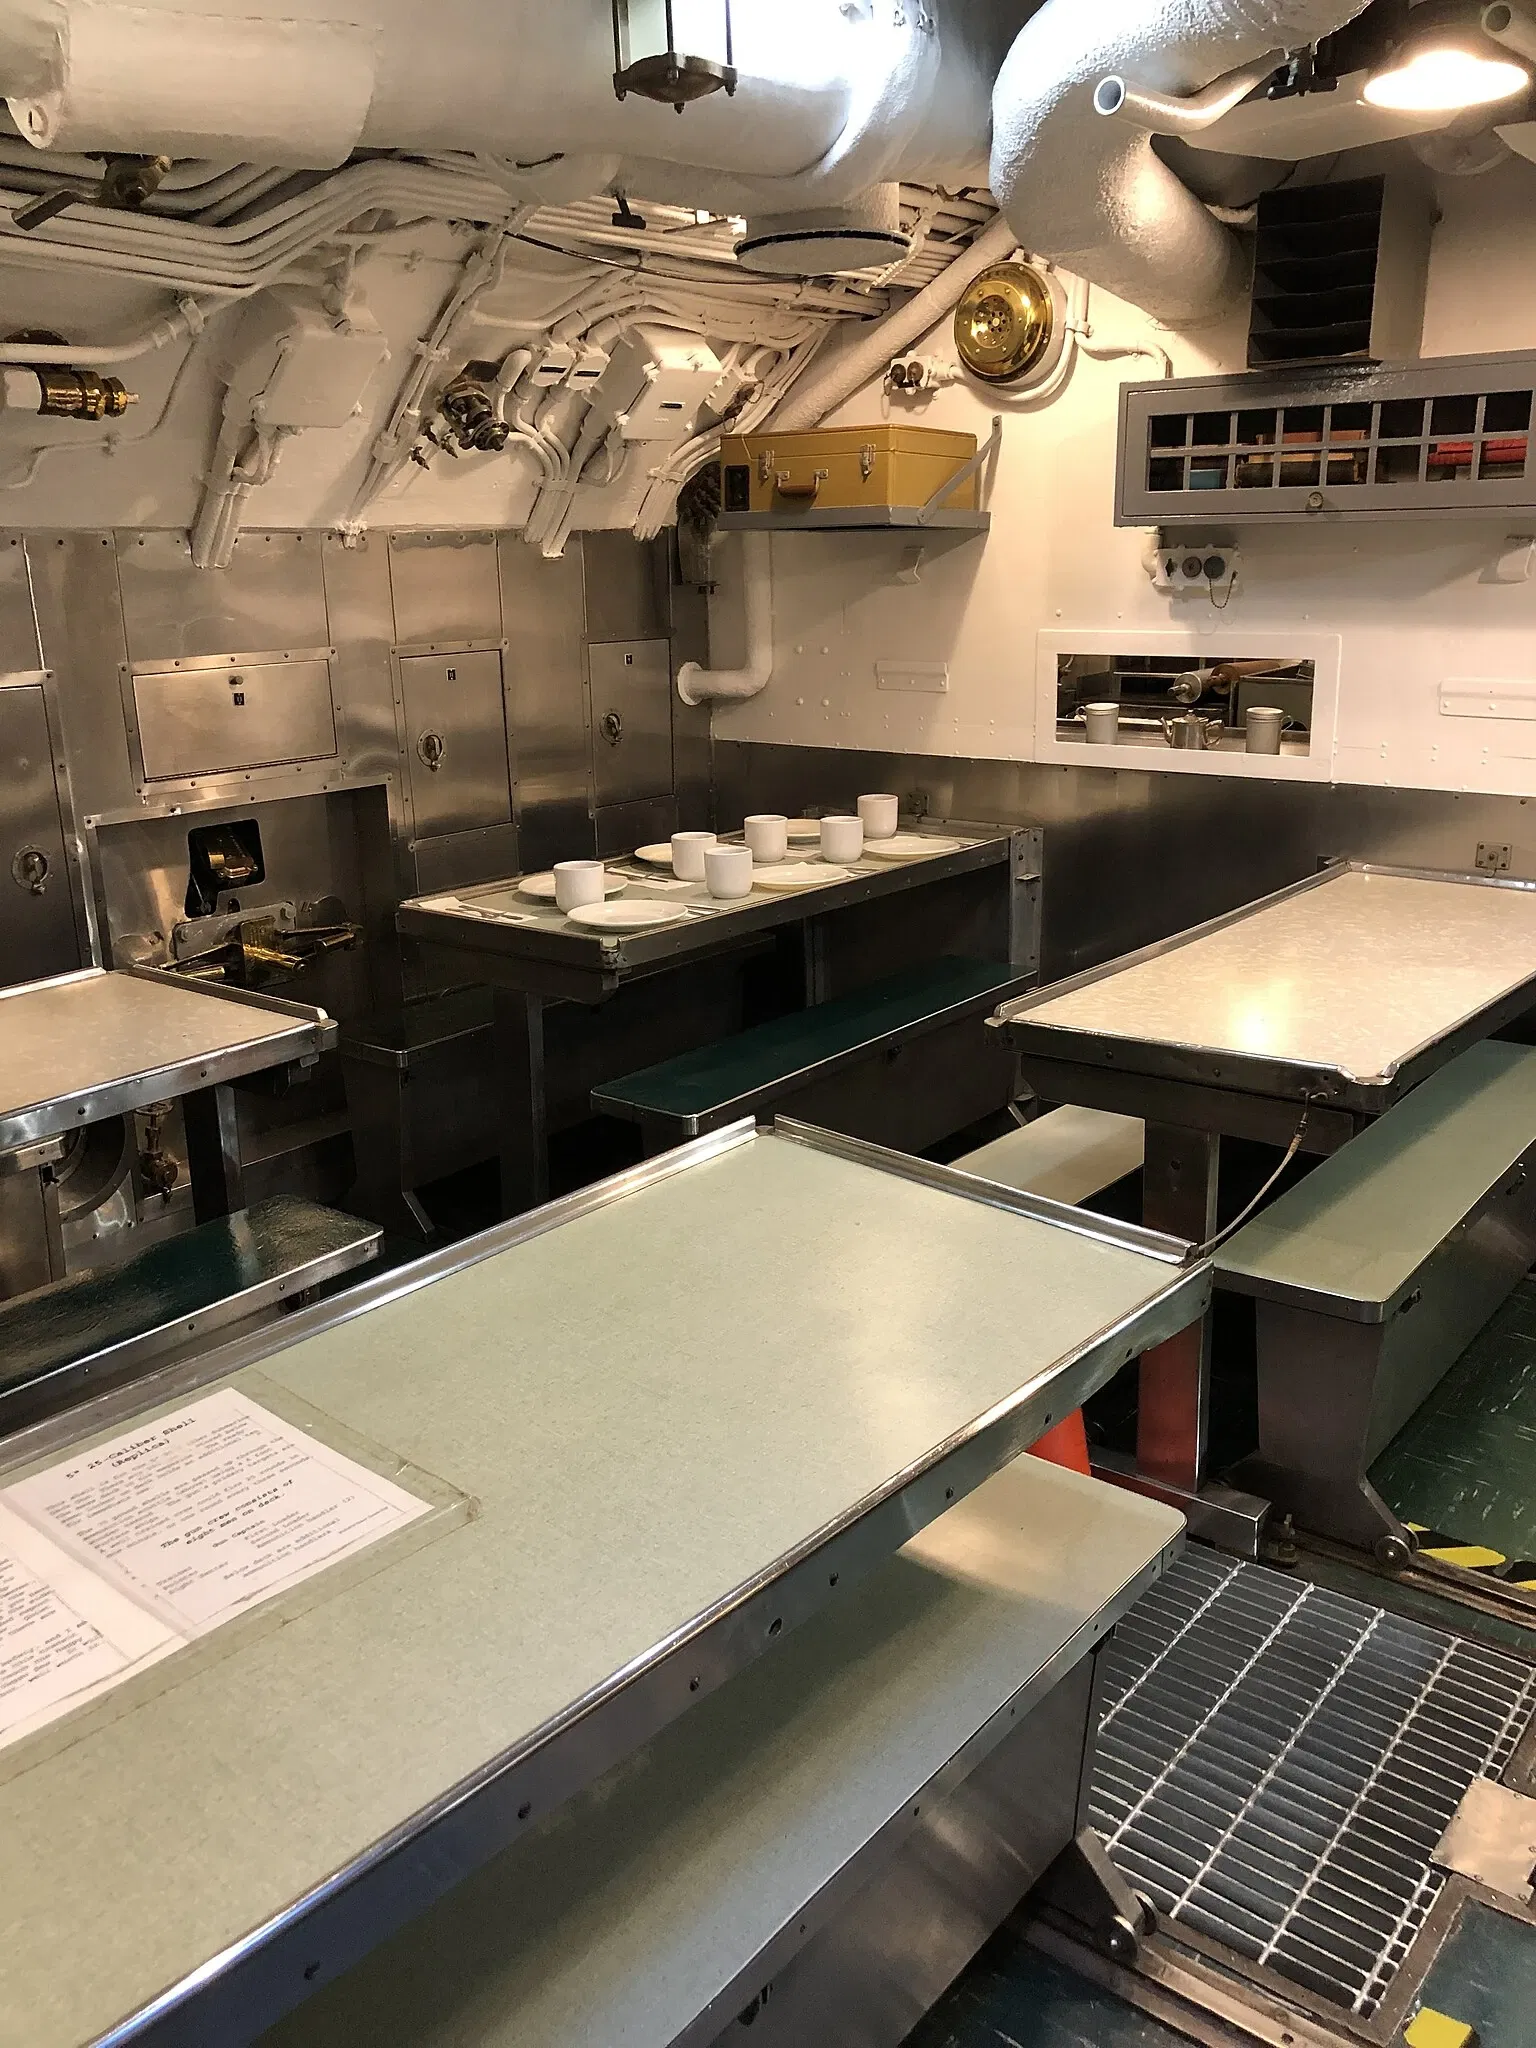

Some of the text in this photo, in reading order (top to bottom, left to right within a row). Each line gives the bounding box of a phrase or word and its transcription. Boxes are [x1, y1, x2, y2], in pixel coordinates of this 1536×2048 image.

[88, 1434, 158, 1469] 25-Caliber
[162, 1418, 197, 1435] Shell
[111, 1438, 171, 1468] (Replica)
[160, 1478, 295, 1547] The gun crew consists of
[184, 1528, 216, 1545] eight
[218, 1516, 239, 1527] men
[240, 1508, 254, 1516] on
